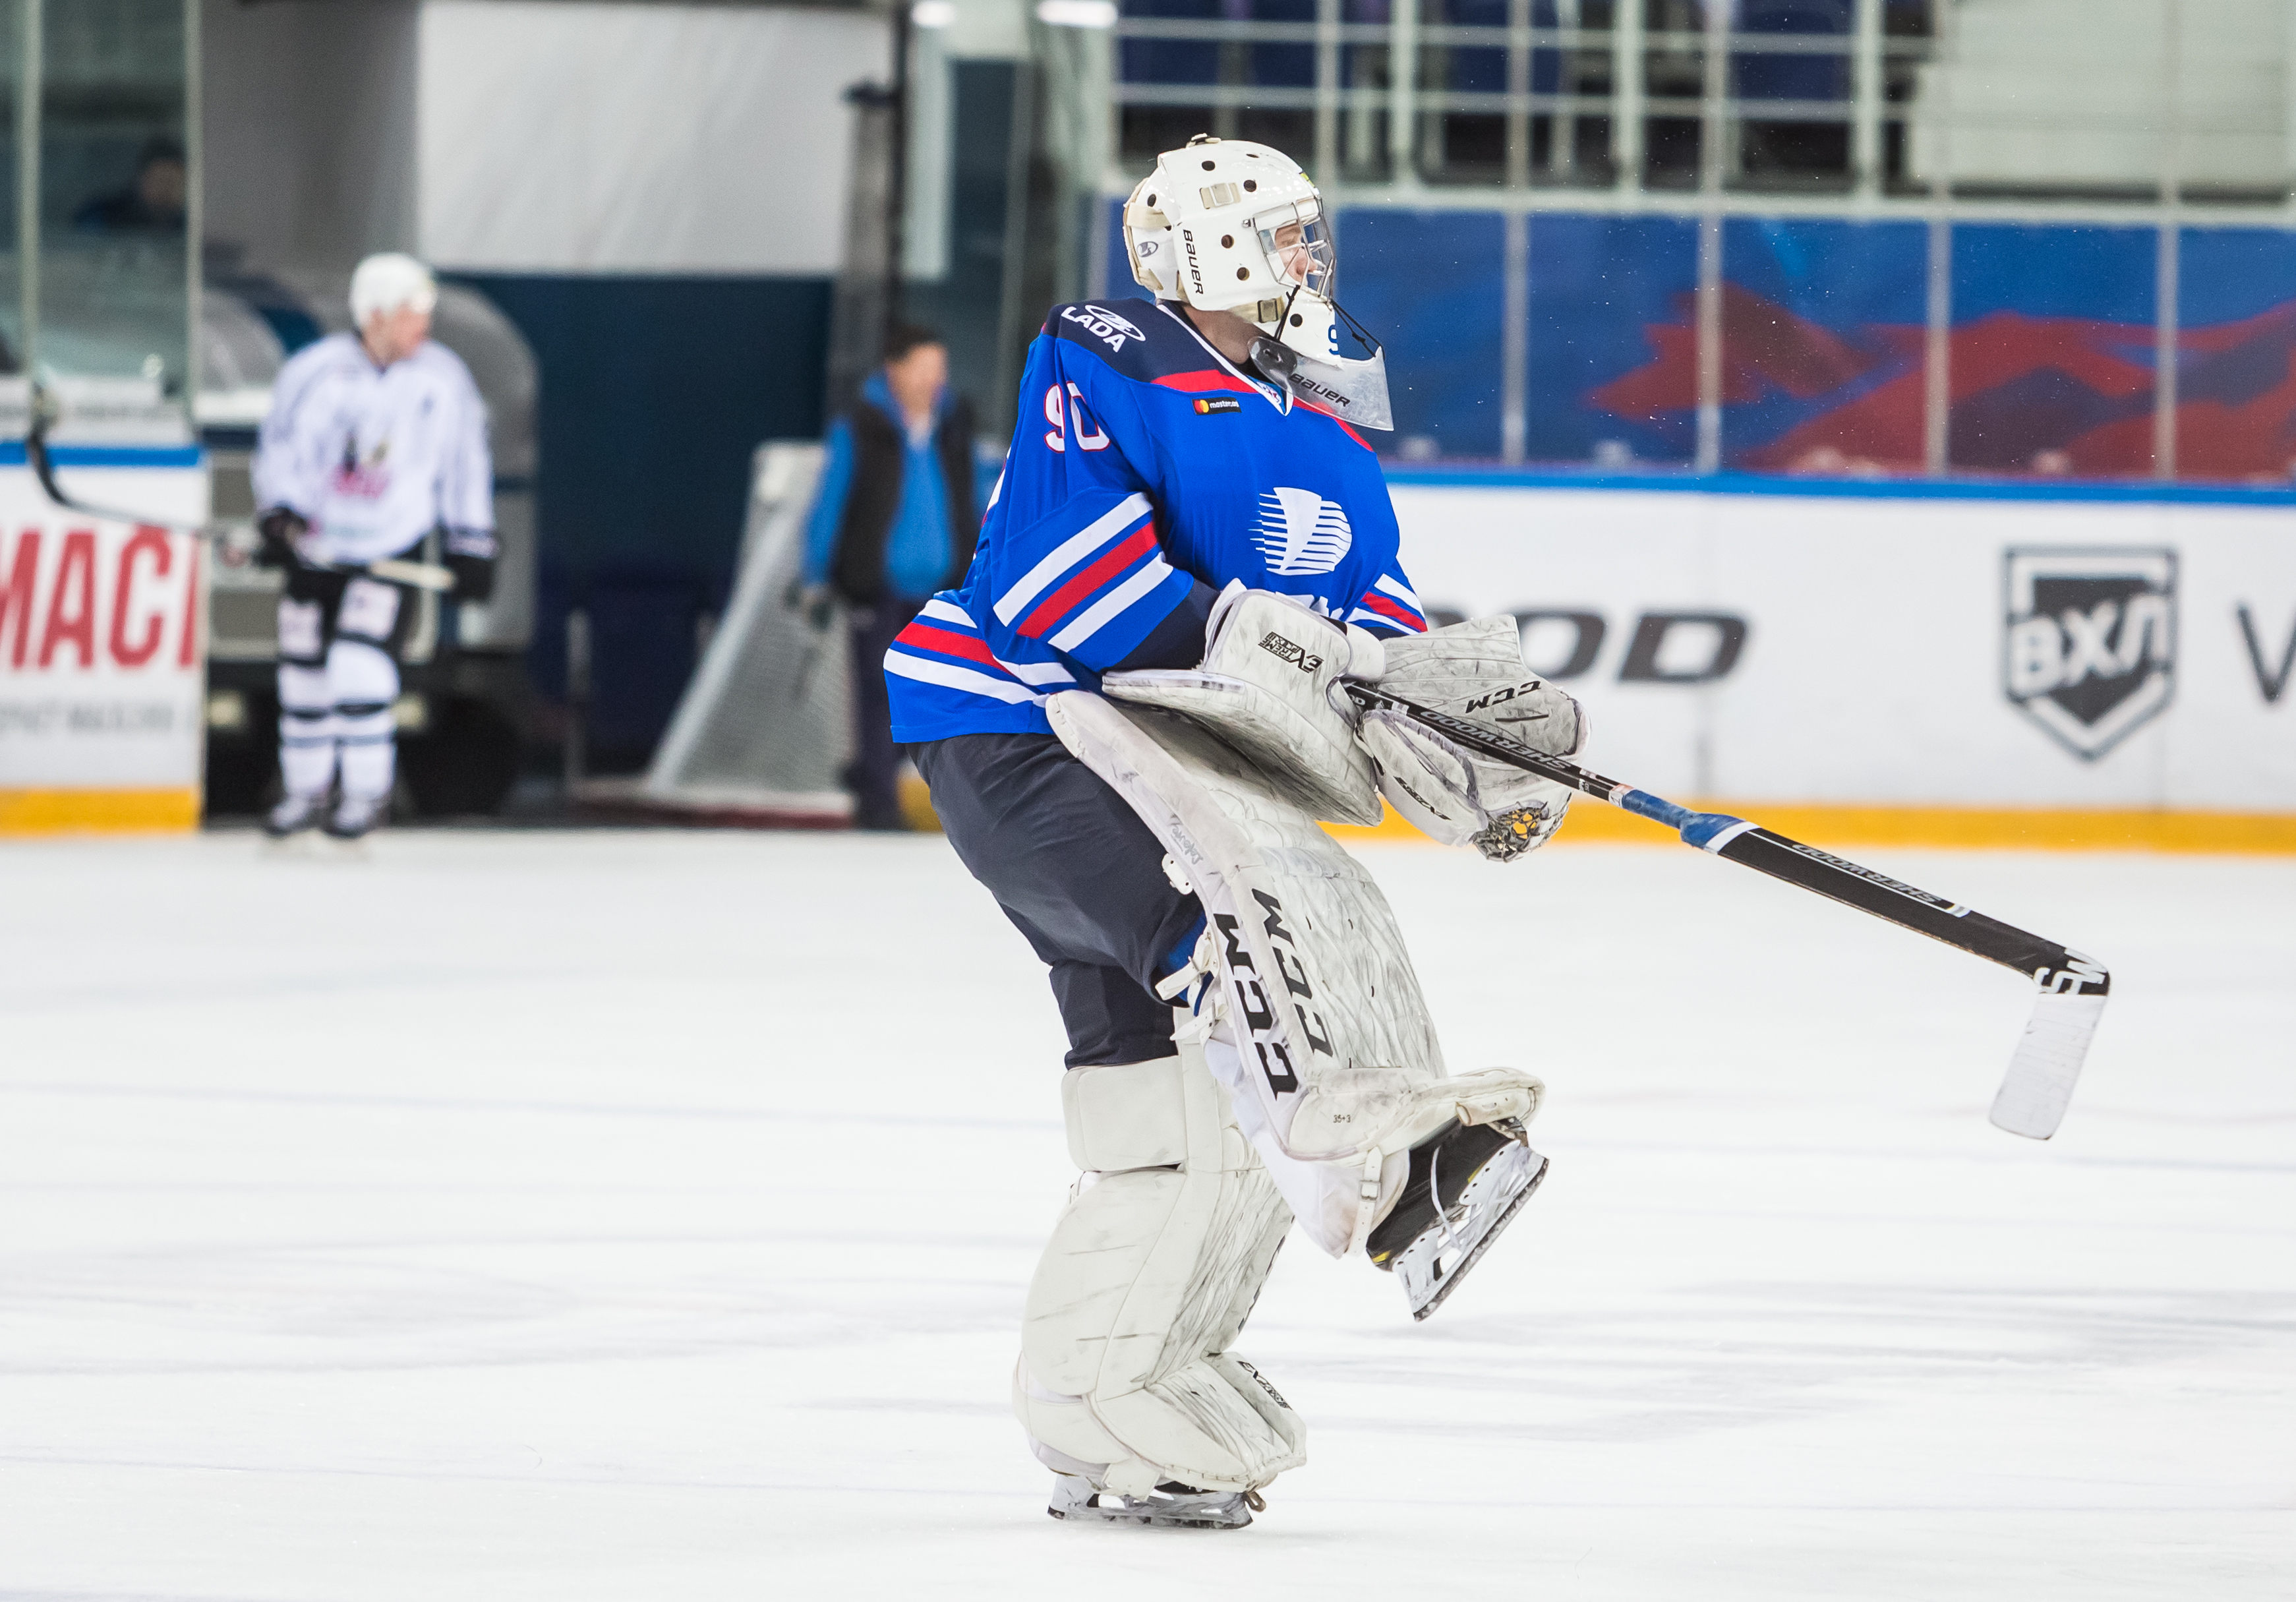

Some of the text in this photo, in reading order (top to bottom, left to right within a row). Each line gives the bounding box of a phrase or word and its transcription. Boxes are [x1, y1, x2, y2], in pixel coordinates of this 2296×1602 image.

[1061, 306, 1126, 353] LADA
[1043, 380, 1112, 454] 90
[2009, 592, 2169, 695] ВХЛ
[1465, 680, 1541, 713] CCM
[1214, 914, 1299, 1102] CCM
[1251, 888, 1333, 1057] CCM
